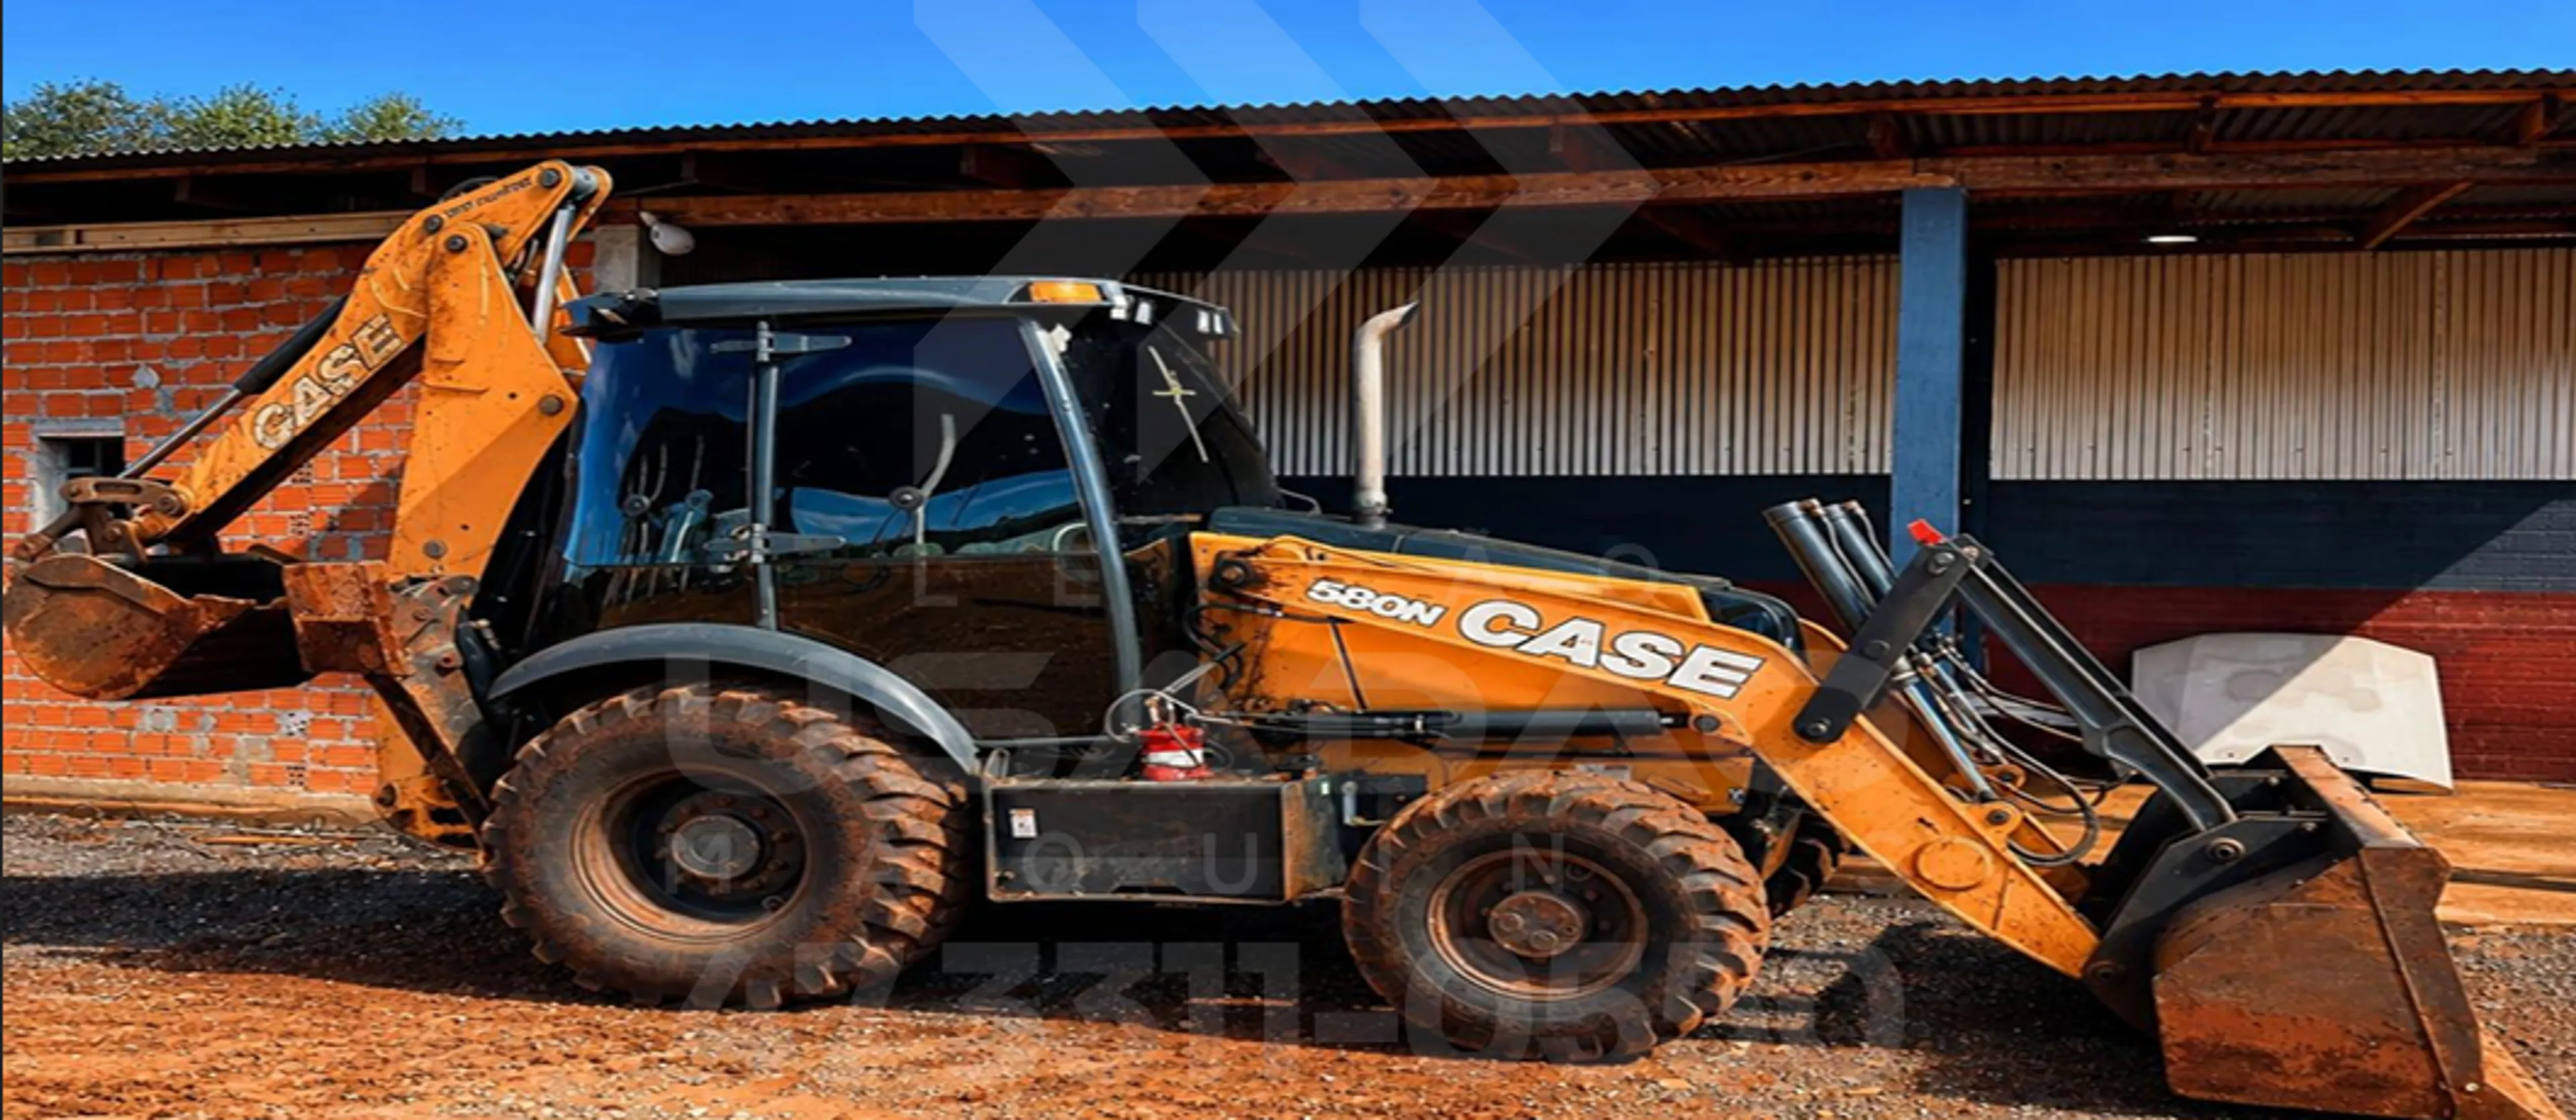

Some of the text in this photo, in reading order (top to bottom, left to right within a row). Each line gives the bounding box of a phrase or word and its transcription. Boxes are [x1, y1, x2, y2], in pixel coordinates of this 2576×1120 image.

[252, 313, 407, 451] CASE
[1307, 579, 1764, 699] 580N CASE
